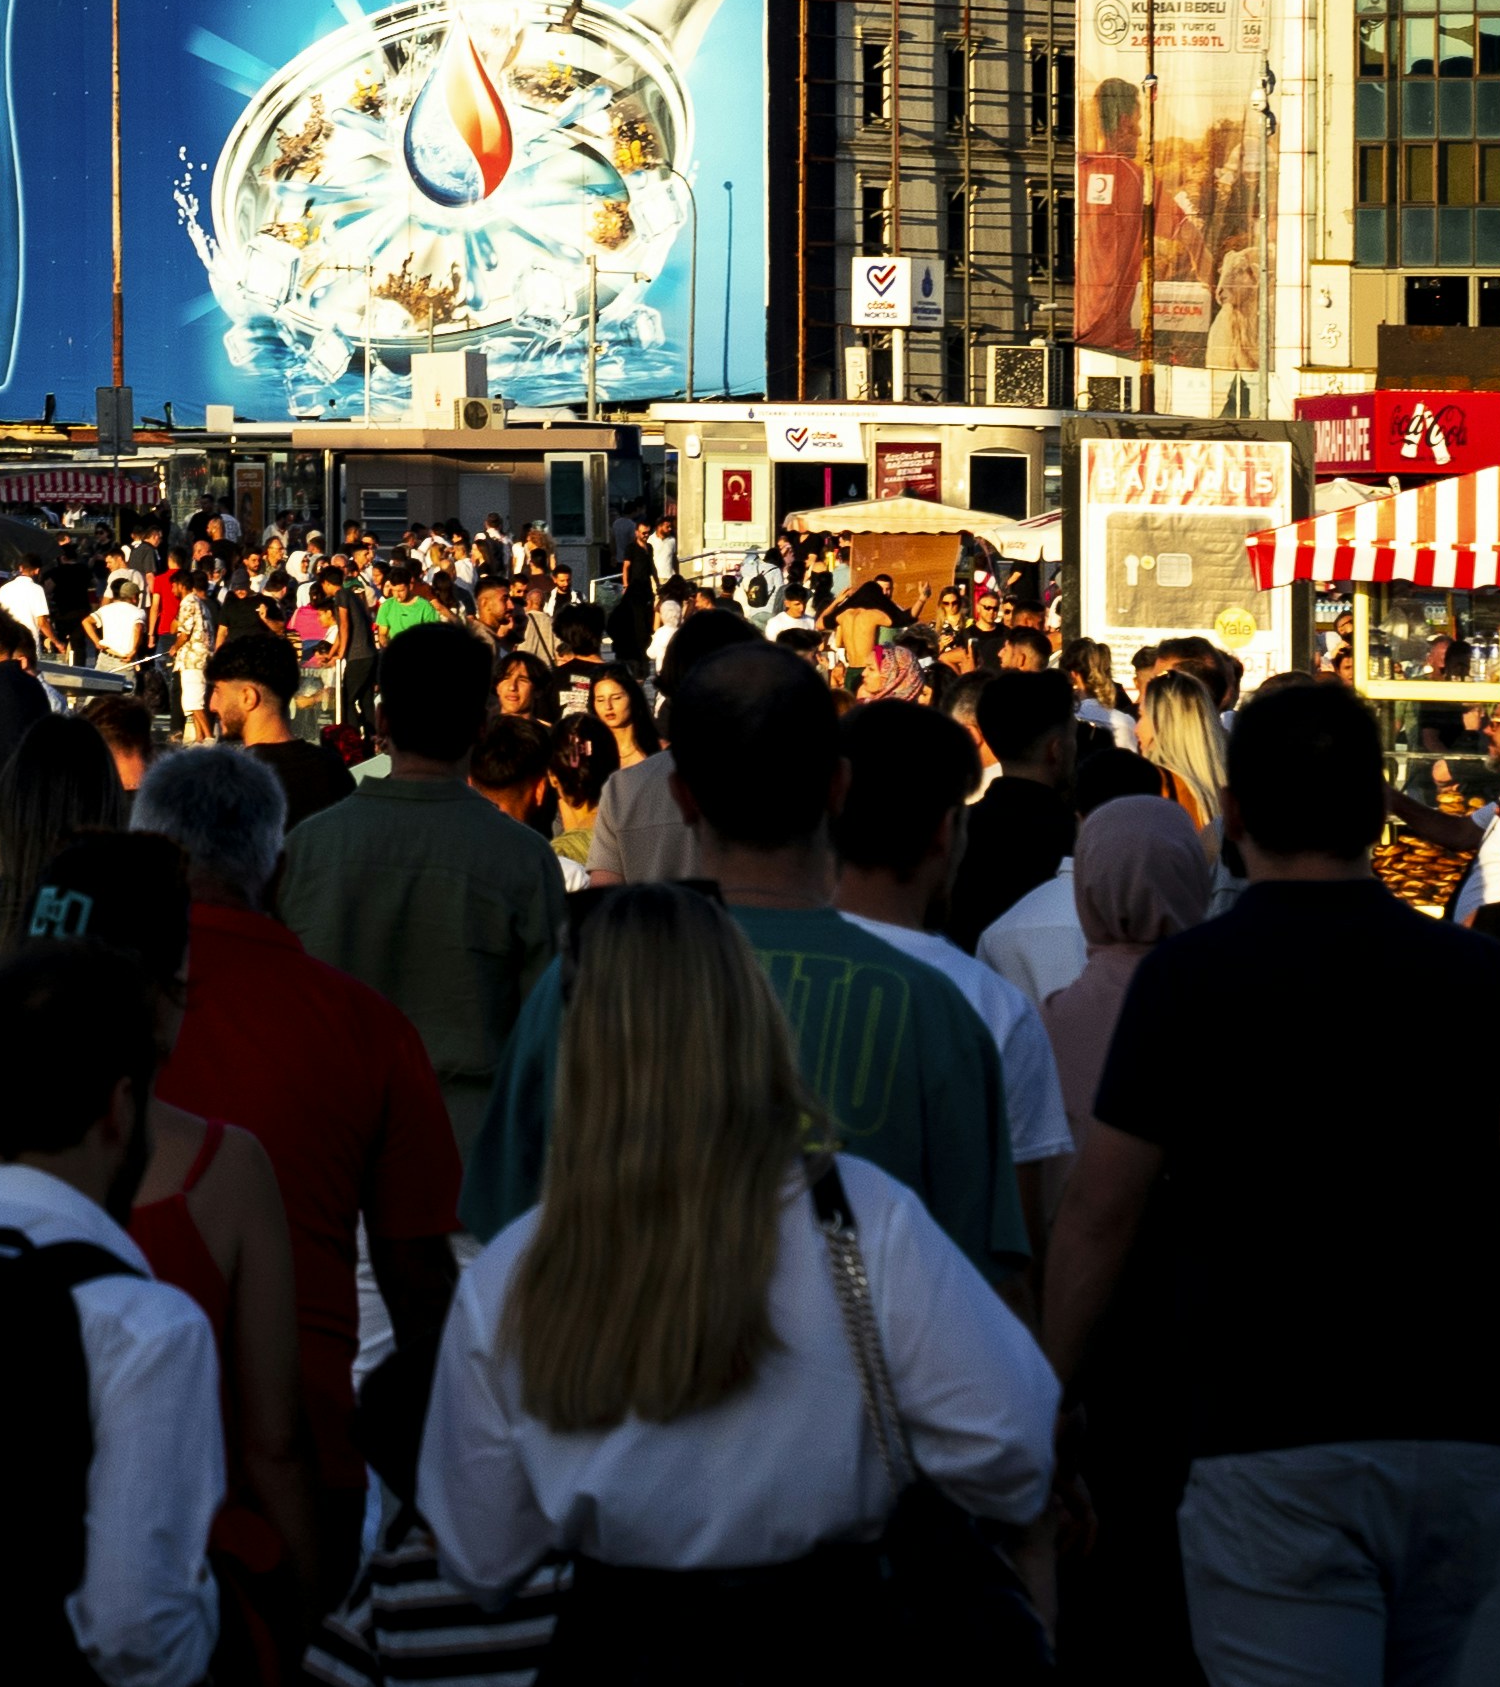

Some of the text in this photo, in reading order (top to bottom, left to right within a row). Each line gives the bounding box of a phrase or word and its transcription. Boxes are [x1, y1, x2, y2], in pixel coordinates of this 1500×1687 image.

[1184, 1, 1226, 13] BEDELİ
[1314, 419, 1344, 463] MRAH
[1099, 467, 1275, 495] BAUHAUS
[1218, 620, 1252, 637] Yale
